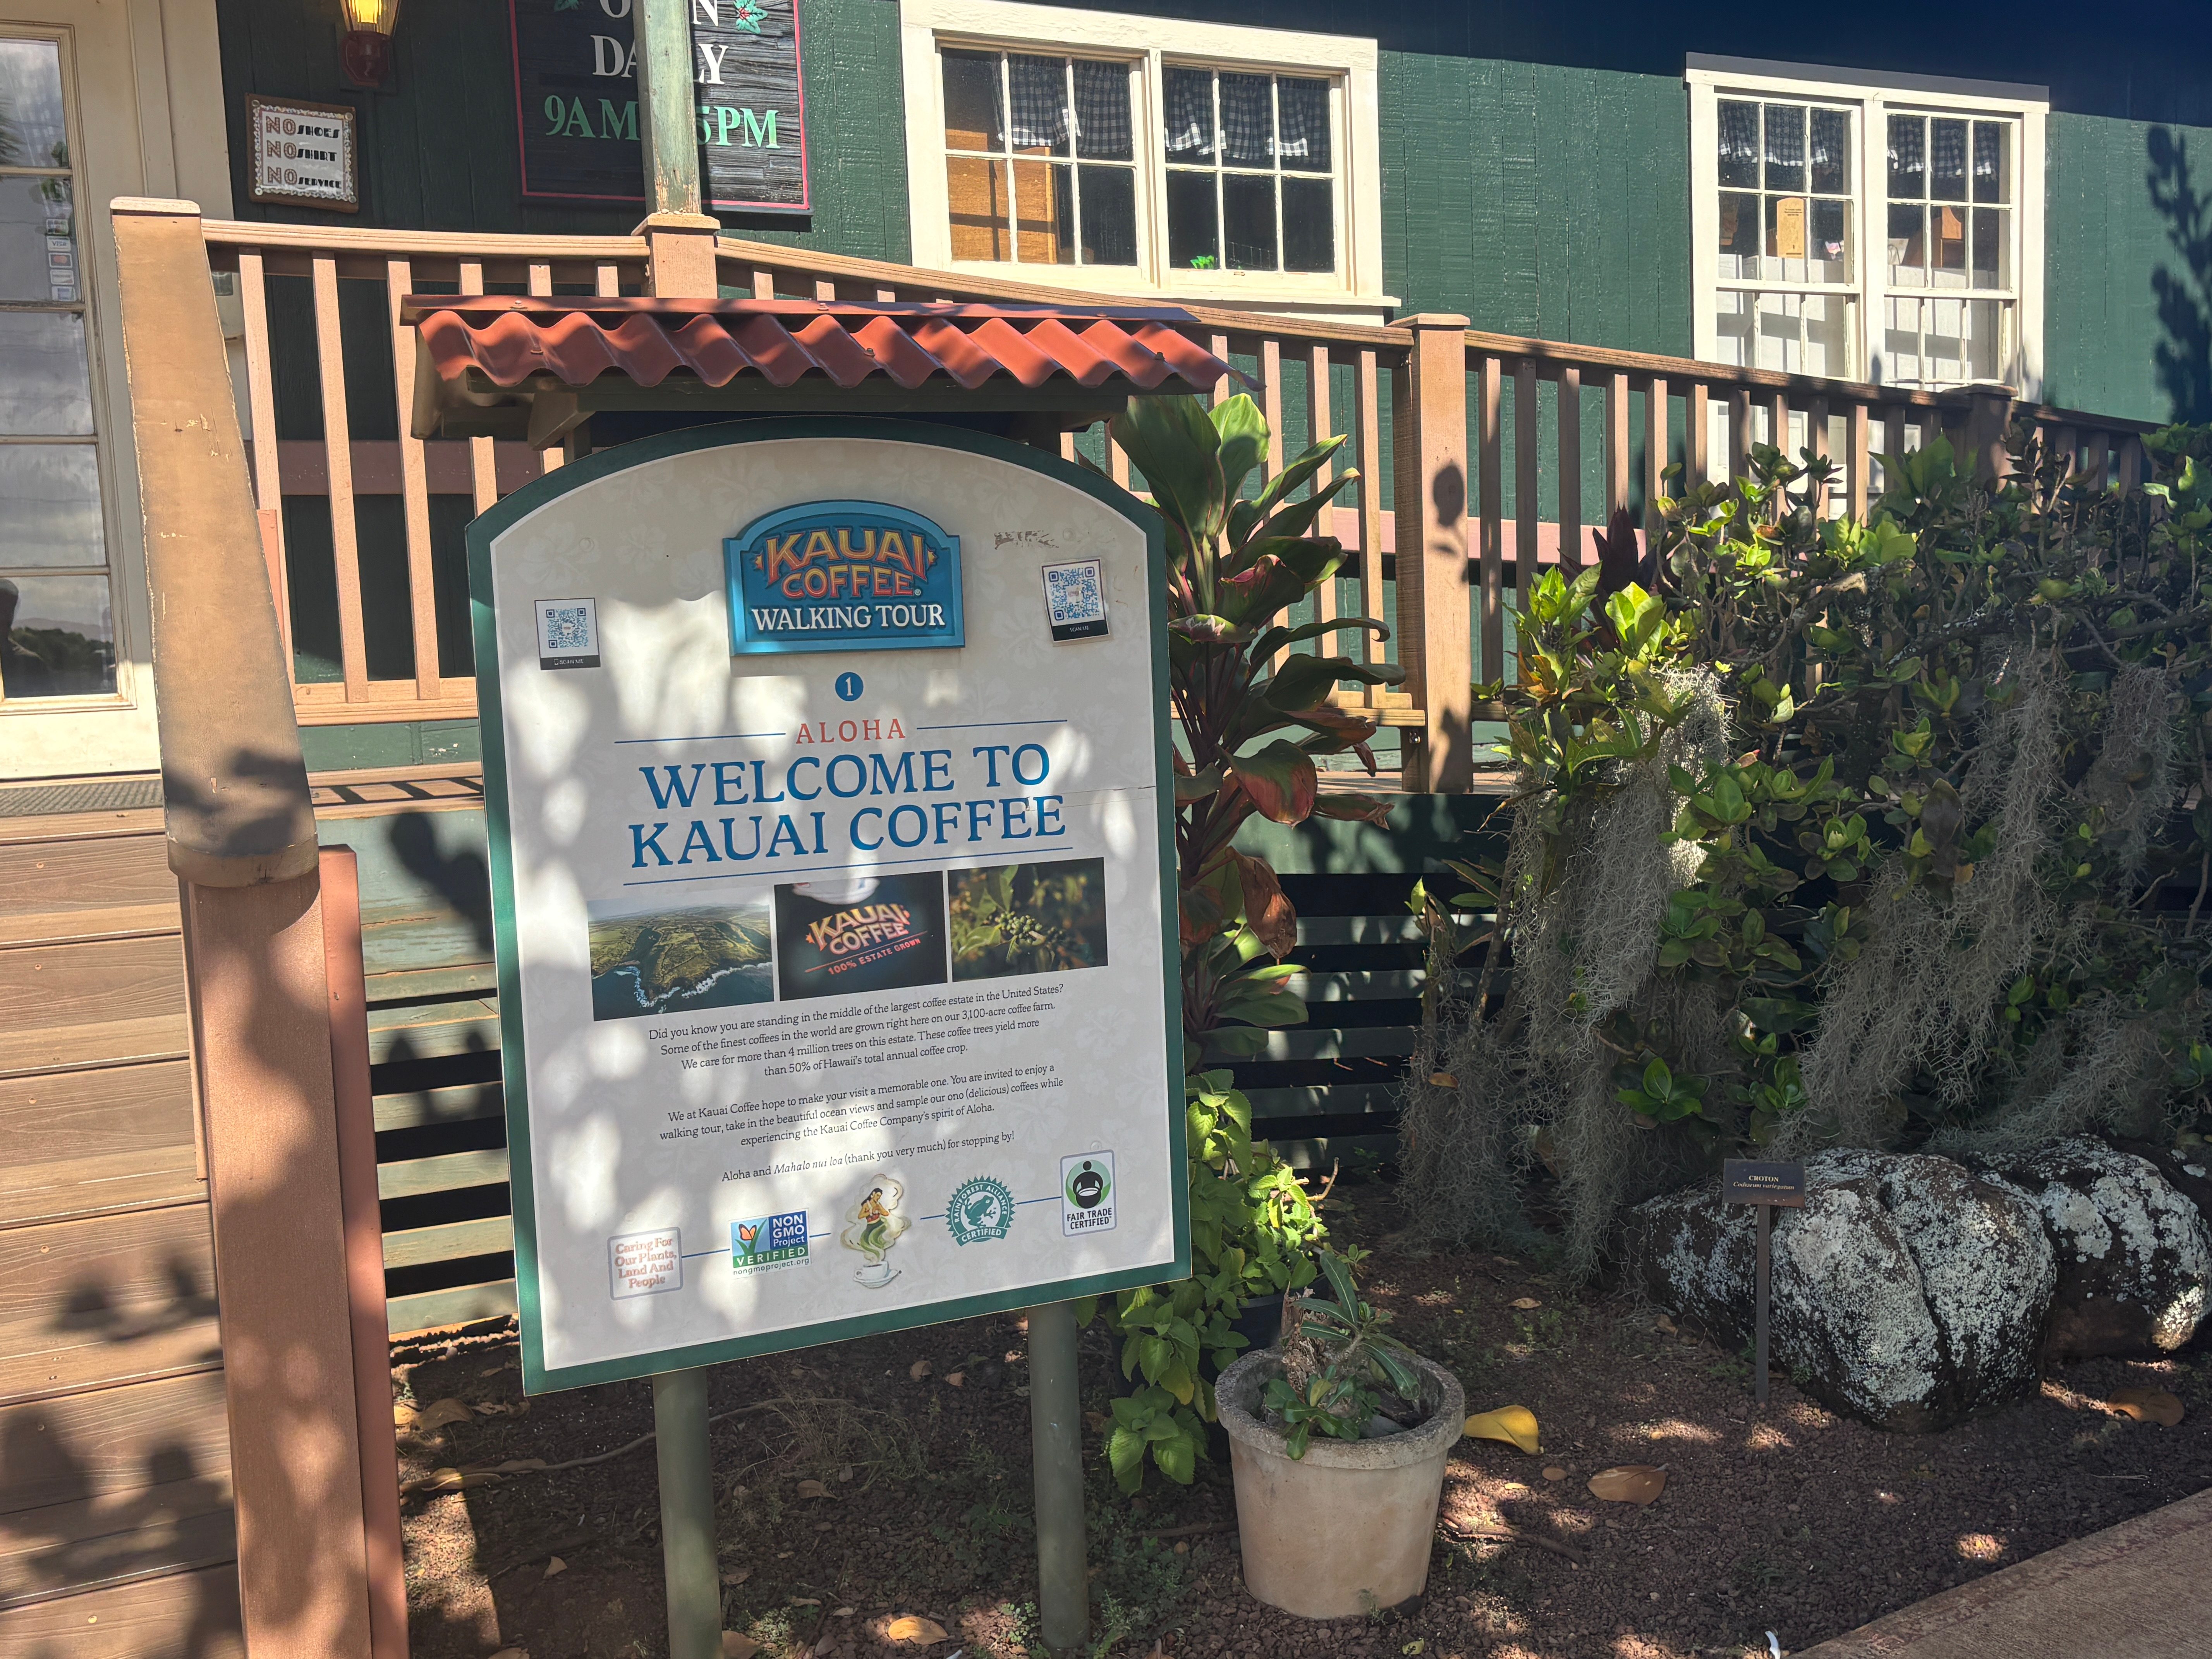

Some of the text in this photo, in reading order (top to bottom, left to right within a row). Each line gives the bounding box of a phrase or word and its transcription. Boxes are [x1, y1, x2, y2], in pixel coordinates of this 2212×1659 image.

[266, 116, 340, 138] NO SHOES
[544, 95, 781, 149] 9AM 5PM
[266, 140, 337, 161] NO SHIRT
[268, 166, 342, 189] NO SERVICE
[766, 529, 927, 586] KAUAI
[781, 564, 913, 598] COFFEE
[751, 604, 945, 631] WALKING TOUR
[845, 677, 854, 696] 1
[795, 718, 906, 744] ALOHA
[639, 743, 1050, 810] WELCOME TO
[628, 795, 1066, 868] KAUAI COFFEE
[808, 903, 910, 951] KAUAI
[829, 922, 909, 955] COFFEE
[828, 938, 921, 975] 100% ESTATE GROWN
[648, 983, 1063, 1040] Did you know you are standing in the middle of the largest coffee estate in the United States?
[661, 1045, 689, 1055] Some
[691, 1041, 702, 1052] of
[702, 1040, 719, 1050] the
[720, 1037, 747, 1048] finest
[749, 1033, 780, 1045] coffees
[781, 1030, 791, 1041] in
[793, 1029, 809, 1039] the
[810, 1025, 837, 1037] world
[839, 1026, 853, 1034] are
[855, 1022, 885, 1035] grown
[886, 1017, 909, 1030] right
[910, 1016, 929, 1025] here
[945, 1013, 960, 1022] our
[962, 1008, 1006, 1021] 3,100-acre
[1007, 1003, 1031, 1014] coffee
[1033, 1002, 1055, 1012] farm.
[681, 1059, 698, 1070] We
[700, 1058, 720, 1067] care
[721, 1054, 735, 1065] for
[737, 1053, 762, 1063] more
[764, 1049, 787, 1060] than
[788, 1046, 795, 1056] 4
[797, 1044, 830, 1056] million
[831, 1042, 854, 1051] trees
[869, 1036, 886, 1047] this
[888, 1034, 916, 1044] estate.
[917, 1030, 945, 1041] These
[947, 1026, 971, 1037] coffee
[973, 1025, 993, 1034] trees
[994, 1020, 1016, 1034] yield
[1017, 1020, 1039, 1029] more
[764, 1045, 968, 1076] than 50% of Hawaii's total annual coffee crop.
[667, 1111, 685, 1122] We
[687, 1110, 697, 1120] at
[698, 1105, 728, 1118] Kauai
[730, 1101, 760, 1114] Coffee
[761, 1100, 785, 1111] hope
[787, 1098, 796, 1106] to
[798, 1093, 824, 1105] make
[826, 1092, 847, 1104] your
[849, 1086, 869, 1098] visit
[878, 1079, 929, 1094] memorable
[930, 1079, 949, 1087] one.
[950, 1075, 967, 1084] You
[969, 1074, 982, 1082] are
[984, 1067, 1013, 1080] invited
[1015, 1068, 1023, 1076] to
[1025, 1064, 1048, 1077] enjoy
[659, 1077, 1063, 1140] walking tour, take in the beautiful ocean views and sample our ono (delicious) coffees while
[741, 1103, 994, 1147] experiencing the Kauai Coffee Company's spirit of Aloha.
[721, 1130, 1014, 1182] Aloha and Mahalo nui loa (thank you very much) for stopping by!
[954, 1184, 1007, 1223] RAINFOREST ALLIANCE
[1067, 1207, 1112, 1222] FAIR TRADE
[773, 1214, 804, 1228] NON
[773, 1224, 805, 1238] GMO
[1070, 1216, 1109, 1230] CERTIFIED
[615, 1237, 673, 1254] Caring For
[773, 1235, 805, 1247] Project
[961, 1228, 1002, 1242] CERTIFIED
[615, 1250, 677, 1267] Our Plants,
[618, 1260, 674, 1279] Land And
[733, 1258, 809, 1275] nongmoproject.org
[737, 1247, 805, 1266] VERIFIED
[628, 1274, 665, 1288] People
